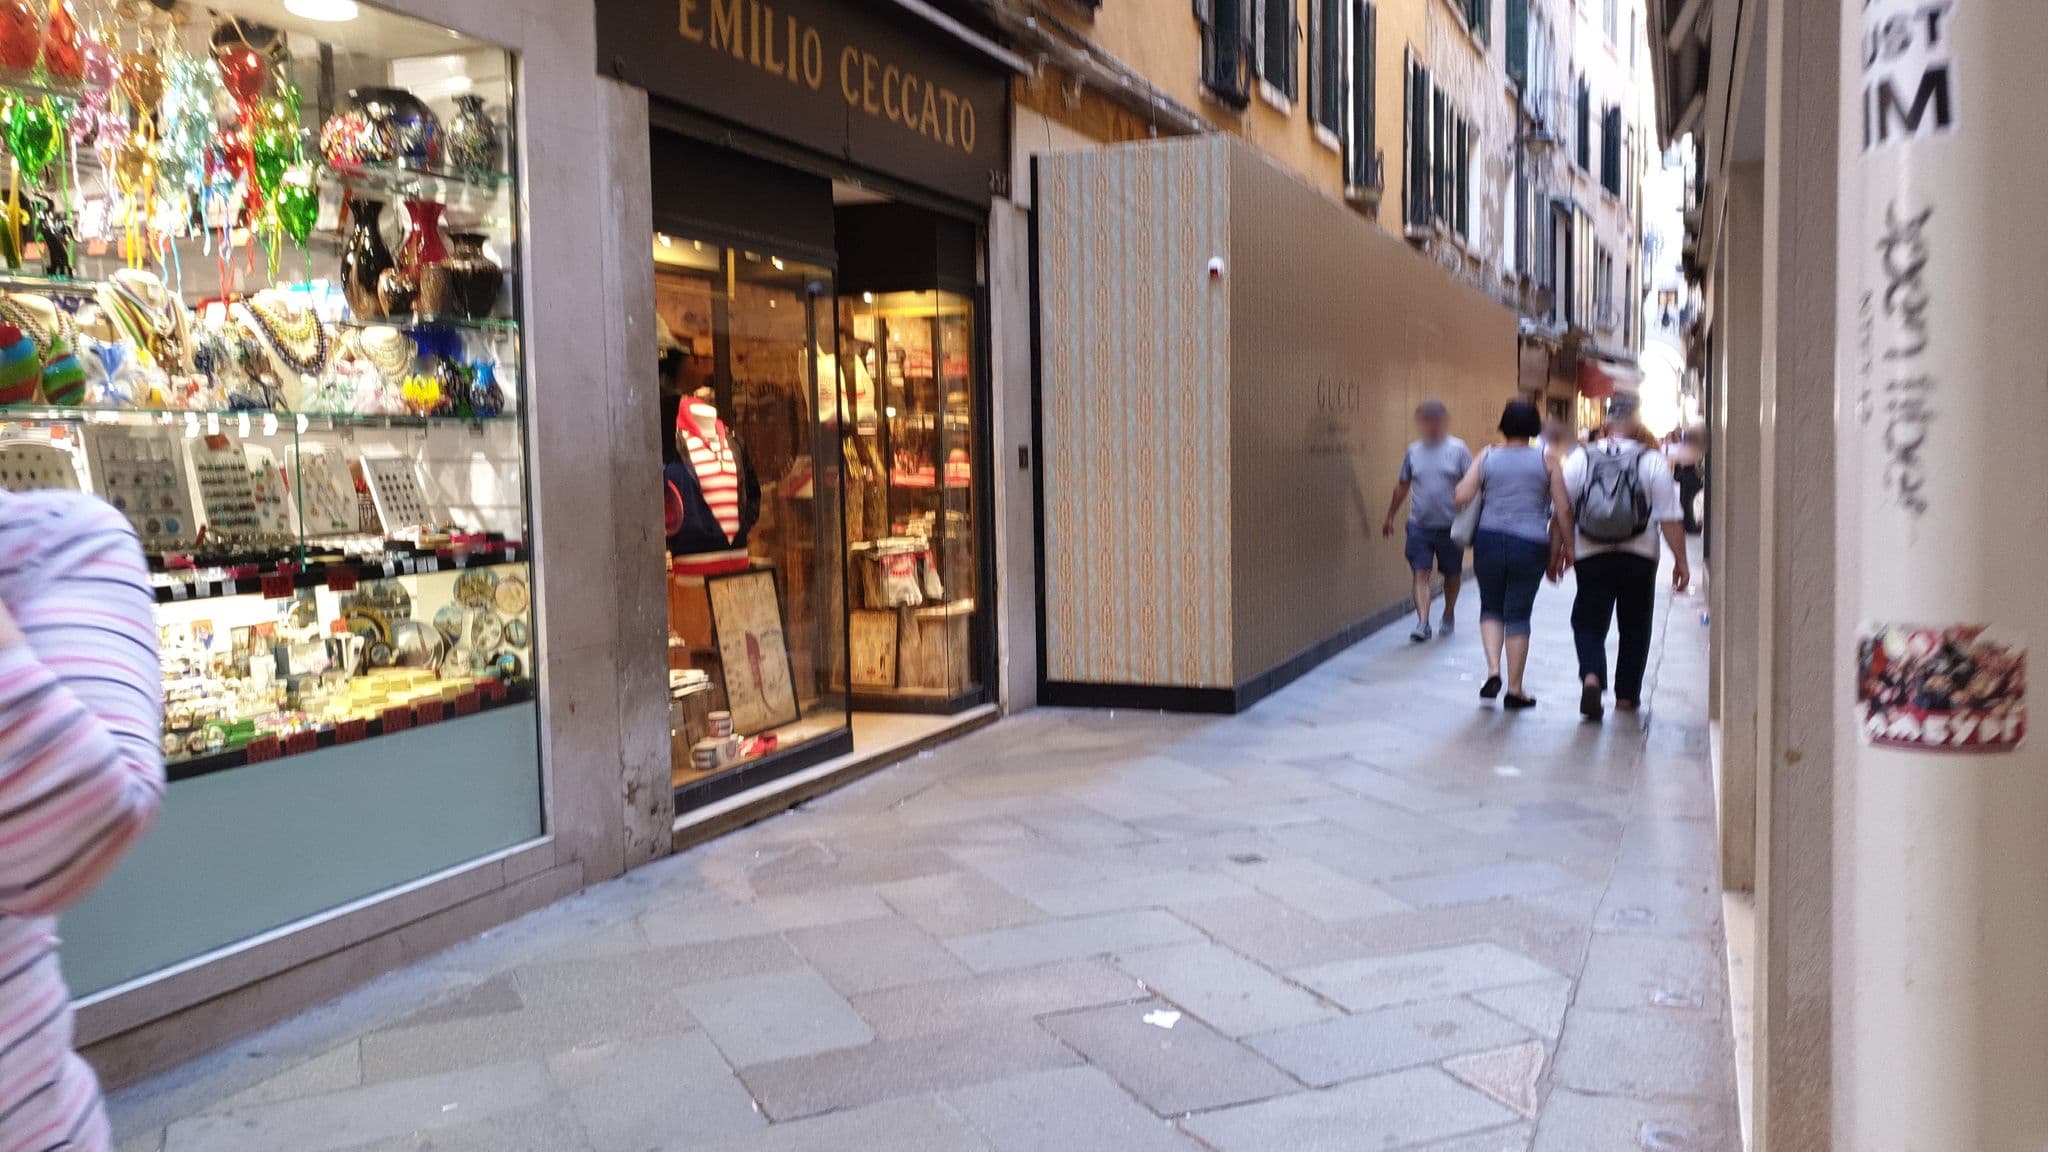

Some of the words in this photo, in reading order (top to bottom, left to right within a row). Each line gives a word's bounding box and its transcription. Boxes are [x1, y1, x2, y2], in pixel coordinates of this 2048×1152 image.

[679, 0, 824, 91] EMILIO
[840, 45, 977, 155] CECCATO
[1316, 374, 1361, 413] GUCCI
